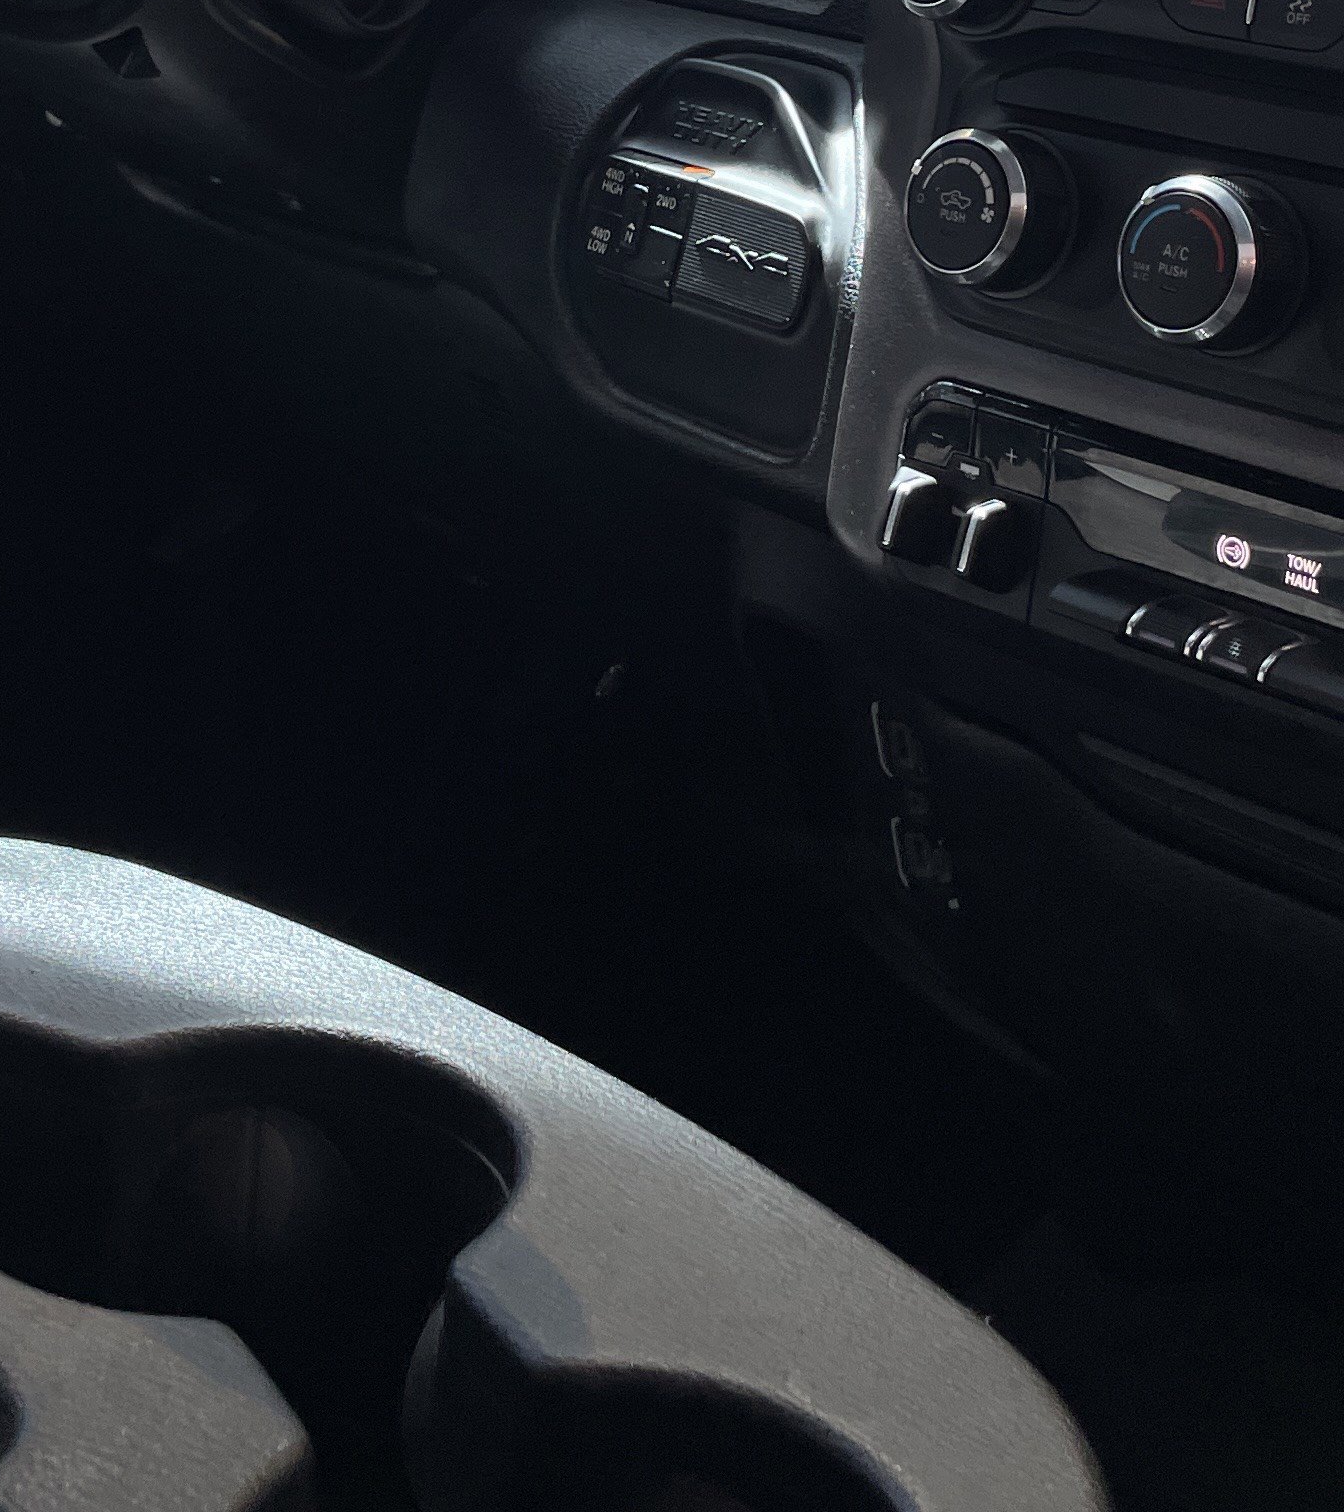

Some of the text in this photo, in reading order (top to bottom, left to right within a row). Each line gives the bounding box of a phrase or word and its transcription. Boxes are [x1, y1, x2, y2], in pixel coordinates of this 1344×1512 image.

[1286, 11, 1312, 25] OFF
[656, 193, 677, 210] 2WD
[587, 237, 609, 255] LOW
[1162, 243, 1190, 261] A/C
[1158, 261, 1188, 279] PUSH
[1286, 553, 1322, 578] TOW/
[1284, 570, 1320, 594] HAUL
